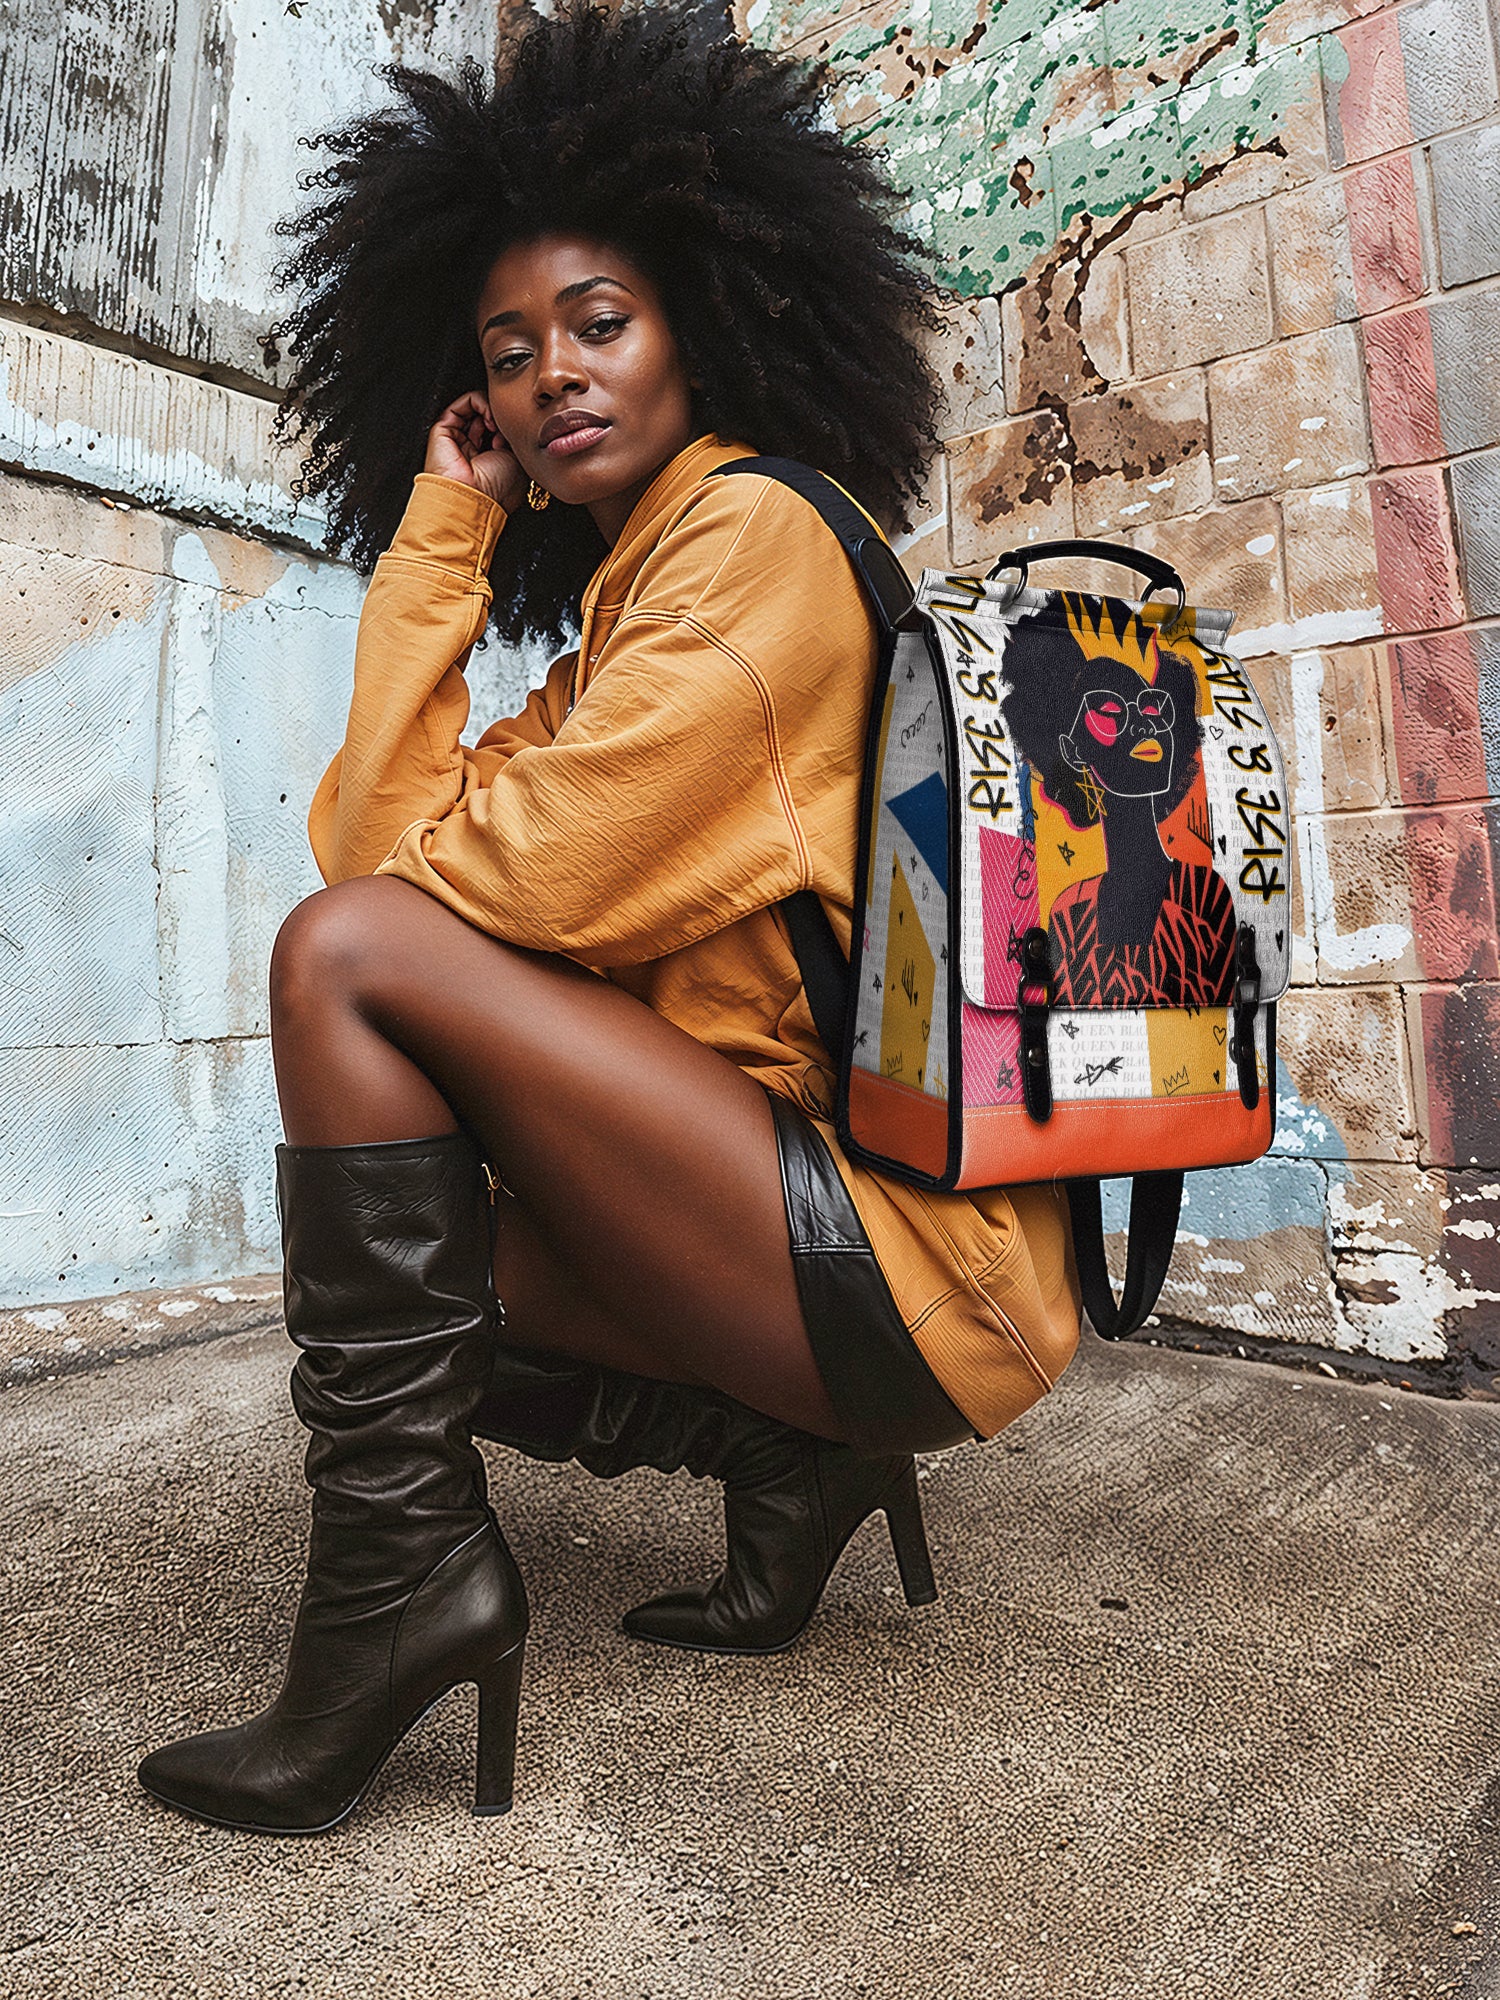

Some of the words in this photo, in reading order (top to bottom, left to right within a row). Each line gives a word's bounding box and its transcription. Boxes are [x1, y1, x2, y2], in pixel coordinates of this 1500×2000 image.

[929, 575, 994, 655] SLA
[956, 669, 999, 704] &
[1188, 634, 1264, 731] SLAY
[963, 714, 1013, 821] RISE
[1227, 744, 1273, 774] &
[1235, 787, 1287, 905] RISE
[1078, 1024, 1115, 1036] UEEN
[1121, 1024, 1148, 1036] BLAC
[1071, 1040, 1116, 1054] QUEEN
[1121, 1040, 1148, 1052] BLAC
[1122, 1056, 1149, 1068] BLAC
[1122, 1072, 1149, 1083] BLAC
[1123, 1087, 1151, 1098] BLAC
